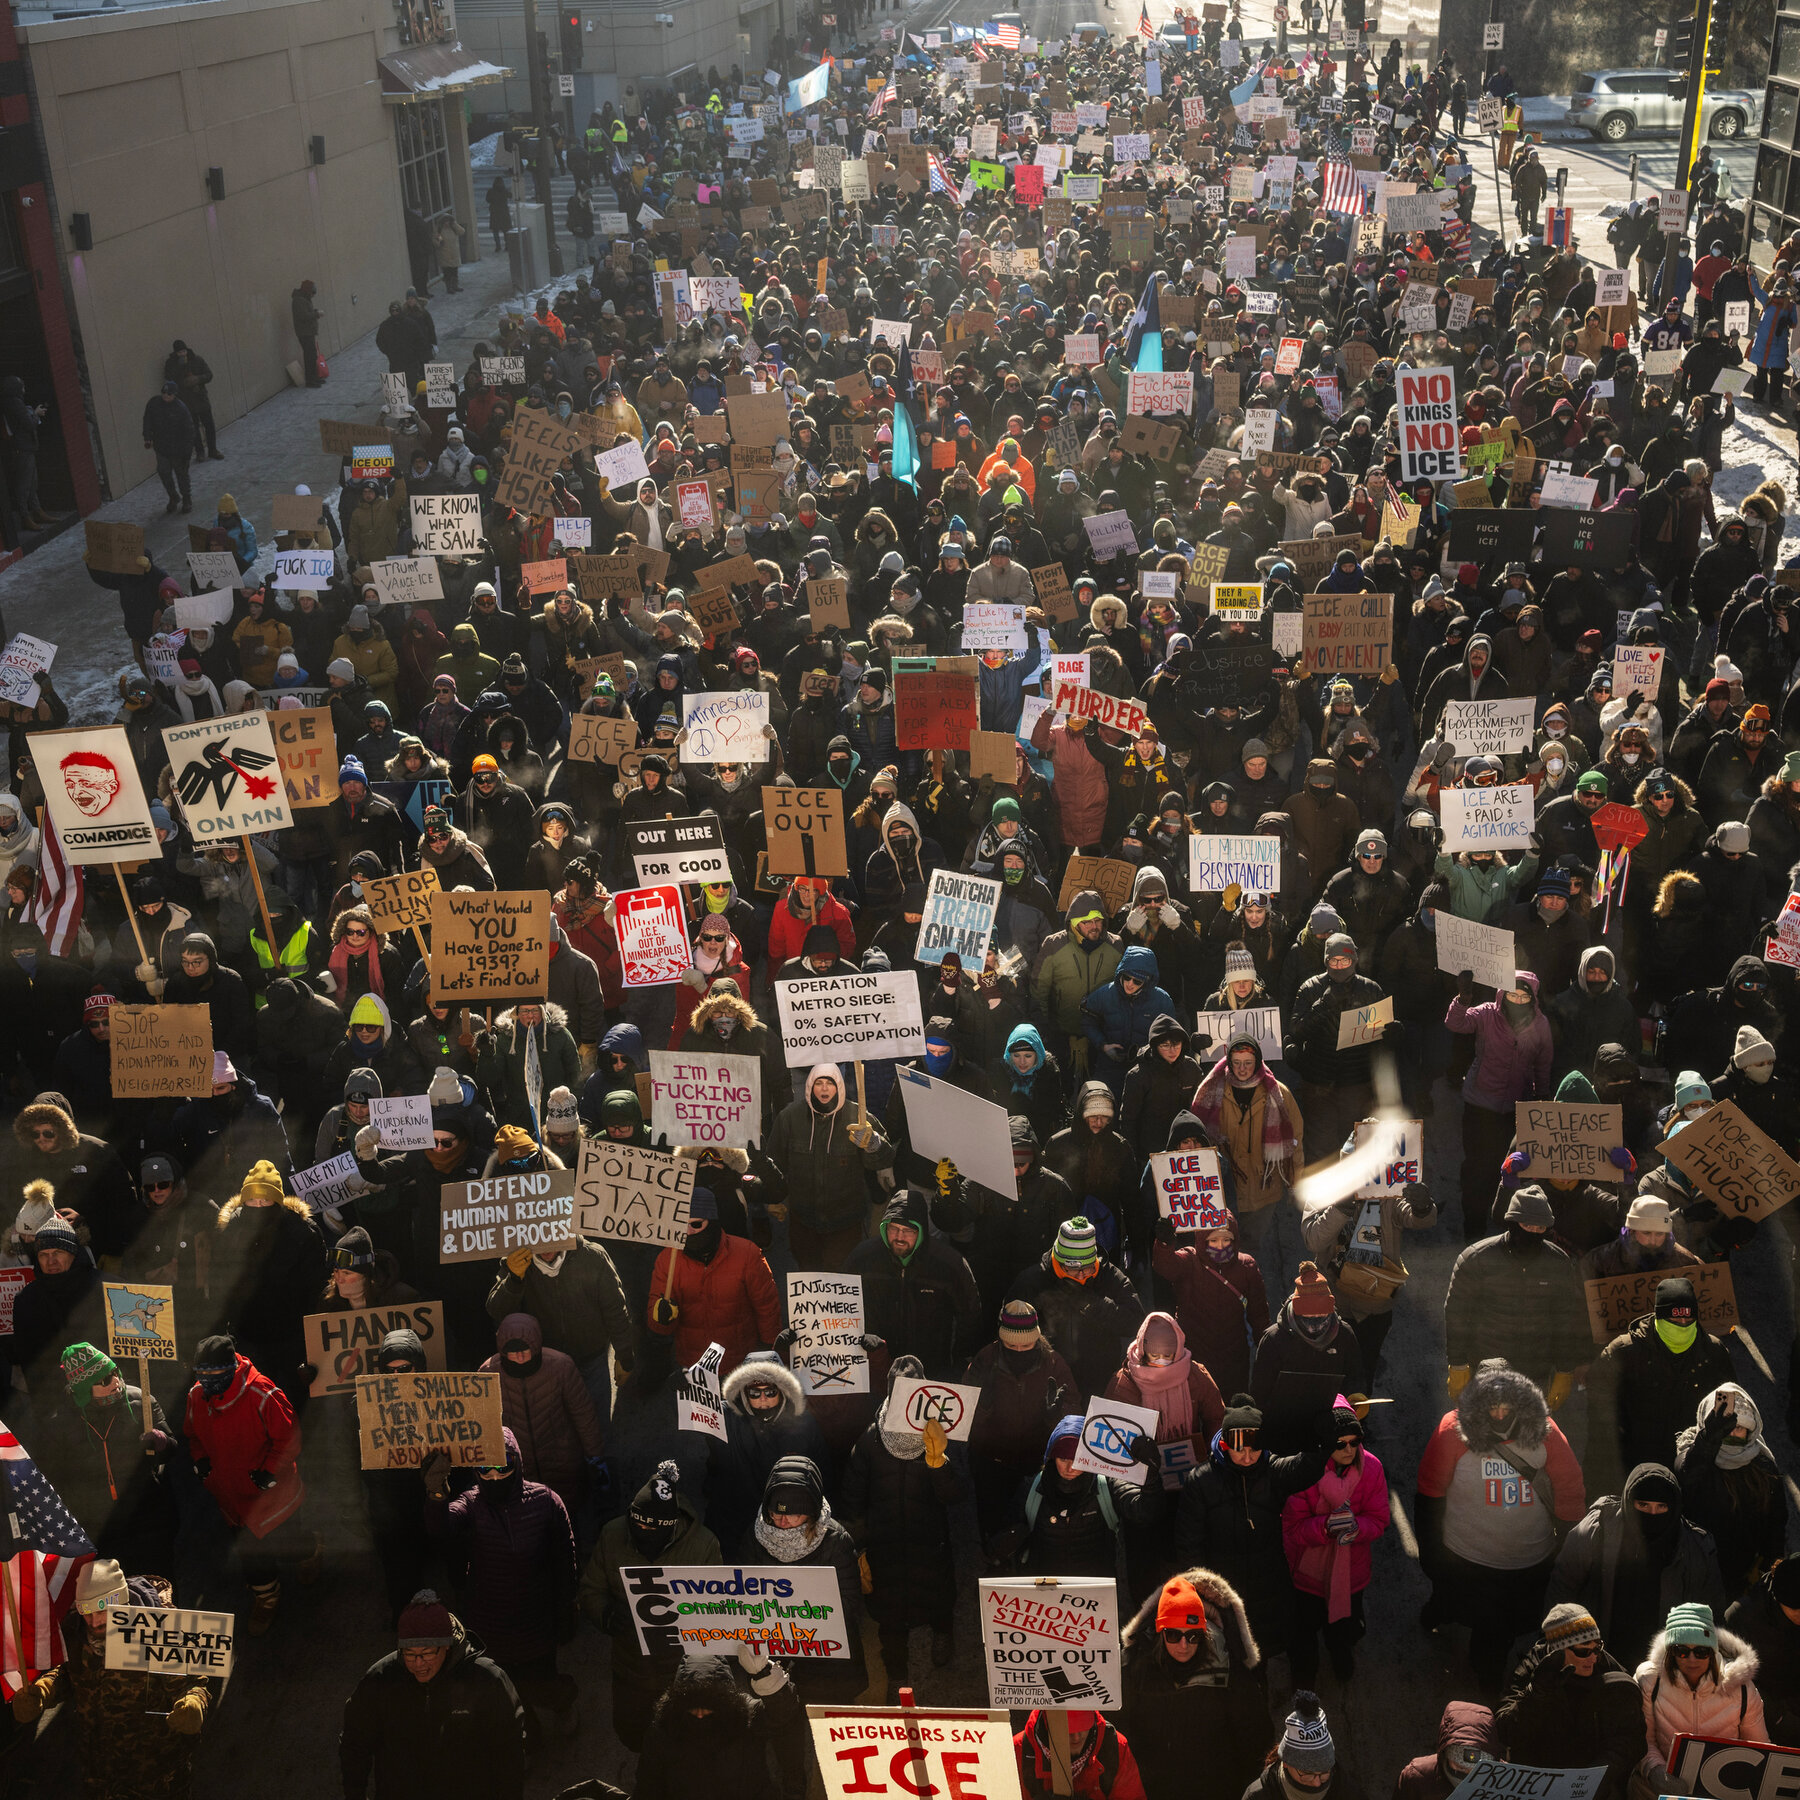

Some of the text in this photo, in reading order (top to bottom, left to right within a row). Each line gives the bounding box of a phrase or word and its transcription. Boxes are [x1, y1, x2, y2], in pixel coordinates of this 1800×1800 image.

[1487, 24, 1500, 32] ONE
[1184, 103, 1204, 111] ICE
[1481, 101, 1499, 110] ONE
[1185, 118, 1206, 127] NOW
[1481, 109, 1499, 120] WAY
[1669, 194, 1680, 204] NO
[1661, 207, 1686, 216] STOPPING
[1358, 246, 1381, 255] SOTA
[1364, 240, 1374, 248] OF
[1411, 269, 1436, 281] ICE
[693, 280, 733, 289] What
[700, 298, 739, 310] FUCK
[1729, 308, 1746, 317] ICE
[1403, 306, 1434, 321] FUCK
[1408, 318, 1432, 330] ICE
[1657, 330, 1680, 350] 84
[1402, 374, 1451, 405] NO
[1248, 411, 1272, 419] JUSTICE
[1404, 404, 1452, 421] KINGS
[1405, 422, 1454, 451] NO
[353, 457, 393, 467] ICE OUT
[1408, 451, 1456, 477] ICE
[362, 468, 387, 478] MSP
[414, 497, 479, 515] WE KNOW
[429, 518, 463, 530] WHAT
[1476, 524, 1500, 533] FUCK
[1579, 516, 1595, 525] NO
[415, 529, 475, 552] WE SAW
[1479, 537, 1498, 546] ICE!
[1578, 530, 1592, 539] ICE
[1573, 539, 1594, 551] MN
[378, 560, 419, 576] TRUMP
[815, 583, 836, 596] ICE
[1217, 587, 1242, 598] THEY R
[814, 594, 840, 608] OUT
[1217, 598, 1247, 609] TREADING
[1307, 599, 1341, 618] ICE
[1360, 599, 1387, 618] CHILL
[1217, 610, 1258, 620] ON YOU TOO
[1307, 622, 1387, 638] A BODY BUT NOT A
[1304, 642, 1388, 670] MOVEMENT
[1058, 660, 1084, 673] RAGE
[687, 693, 765, 728] Minnesota
[1055, 684, 1144, 733] MURDER
[1455, 703, 1499, 718] YOUR
[169, 716, 261, 743] DON'T TREAD
[1448, 714, 1531, 729] GOVERNMENT
[1455, 728, 1524, 740] IS LYING TO
[775, 789, 829, 809] ICE
[197, 806, 283, 834] ON MN
[774, 814, 832, 832] OUT
[1605, 806, 1641, 824] STOP
[63, 826, 152, 845] COWARDICE
[636, 826, 713, 843] OUT HERE
[641, 859, 722, 876] FOR GOOD
[1200, 862, 1273, 890] RESISTANCE!
[370, 870, 435, 901] STOP
[449, 898, 532, 915] What Would
[468, 917, 517, 938] YOU
[641, 927, 660, 937] I.C.E.
[445, 939, 542, 955] Have Done In
[638, 935, 667, 948] OUT OF
[627, 944, 683, 960] MINNEAPOLIS
[467, 956, 520, 972] 1939?
[440, 969, 541, 990] Let's Find Out
[787, 976, 878, 994] OPERATION
[791, 992, 896, 1011] METRO SIEGE:
[114, 1011, 159, 1034] STOP
[794, 1012, 886, 1030] 0% SAFETY,
[116, 1033, 204, 1050] KILLING AND
[784, 1025, 921, 1049] 100% OCCUPATION
[117, 1054, 206, 1072] KIDNAPPING MY
[117, 1077, 205, 1092] NEIGHBORS!!!
[1528, 1109, 1611, 1132] RELEASE
[1550, 1131, 1578, 1143] THE
[1517, 1141, 1612, 1162] TRUMPSTEIN
[1709, 1111, 1800, 1192] MORE PUGS
[584, 1152, 693, 1196] POLICE
[1170, 1156, 1200, 1175] ICE
[1550, 1161, 1595, 1176] FILES
[1705, 1135, 1784, 1206] LESS ICE
[1163, 1175, 1220, 1193] GET THE
[1685, 1144, 1759, 1212] THUGS
[466, 1173, 551, 1204] DEFEND
[579, 1180, 691, 1224] STATE
[1170, 1193, 1216, 1212] FUCK
[112, 1336, 175, 1348] MINNESOTA
[1059, 1593, 1099, 1612] FOR
[988, 1591, 1111, 1634] NATIONAL
[993, 1607, 1090, 1643] STRIKES
[994, 1631, 1026, 1644] TO
[745, 1639, 842, 1656] TRUMP
[993, 1649, 1111, 1664] BOOT OUT
[1000, 1672, 1037, 1683] THE
[1078, 1664, 1114, 1705] ADMIN
[994, 1697, 1053, 1705] CAN'T DO IT ALONE
[829, 1725, 987, 1744] NEIGHBORS SAY
[835, 1745, 988, 1800] ICE
